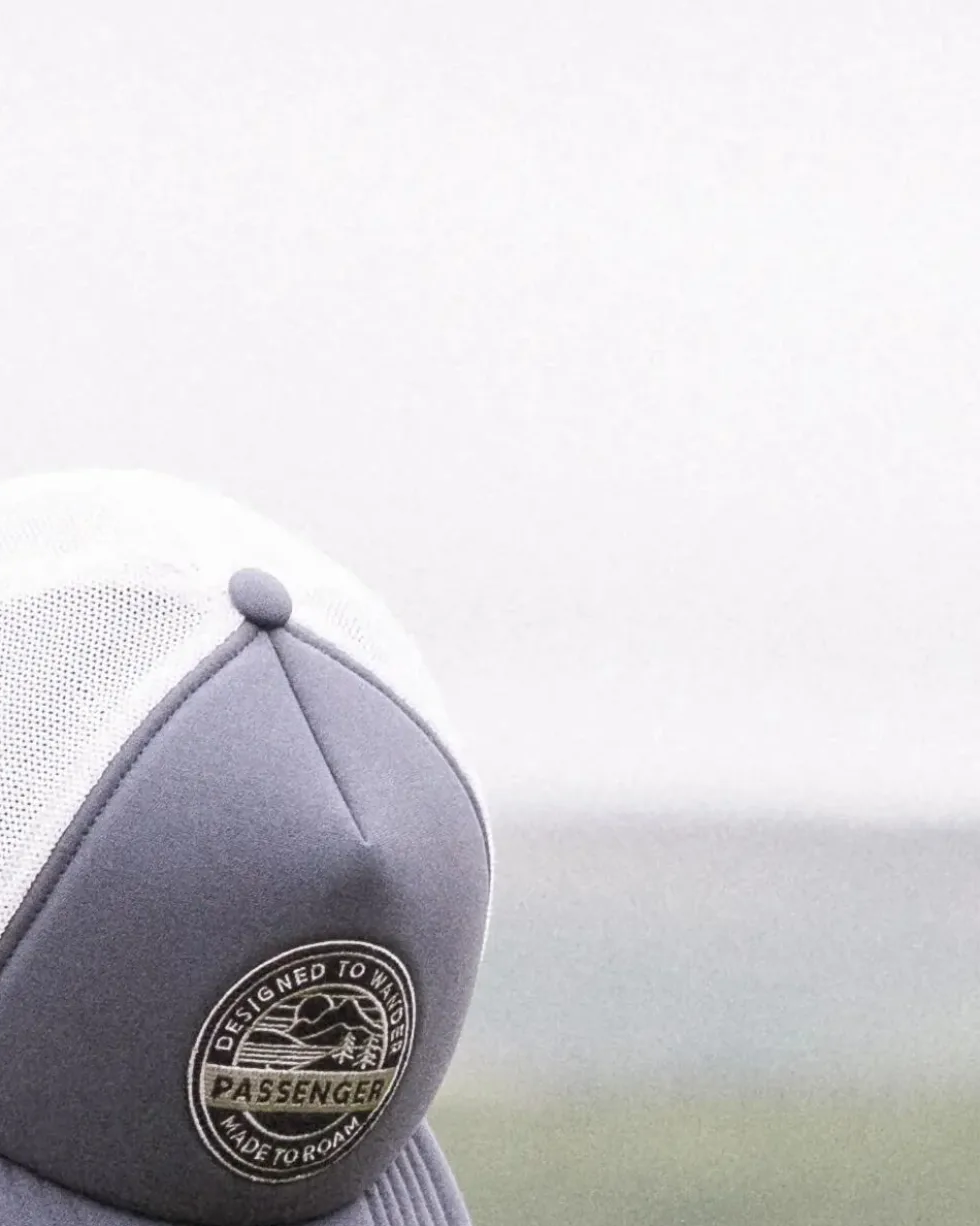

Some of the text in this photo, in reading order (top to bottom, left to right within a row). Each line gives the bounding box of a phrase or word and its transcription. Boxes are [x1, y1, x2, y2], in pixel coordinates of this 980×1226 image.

[215, 961, 405, 1053] DESIGNED TO WANDER
[210, 1077, 385, 1105] PASSENGER
[221, 1115, 360, 1165] MADE TO ROAM
